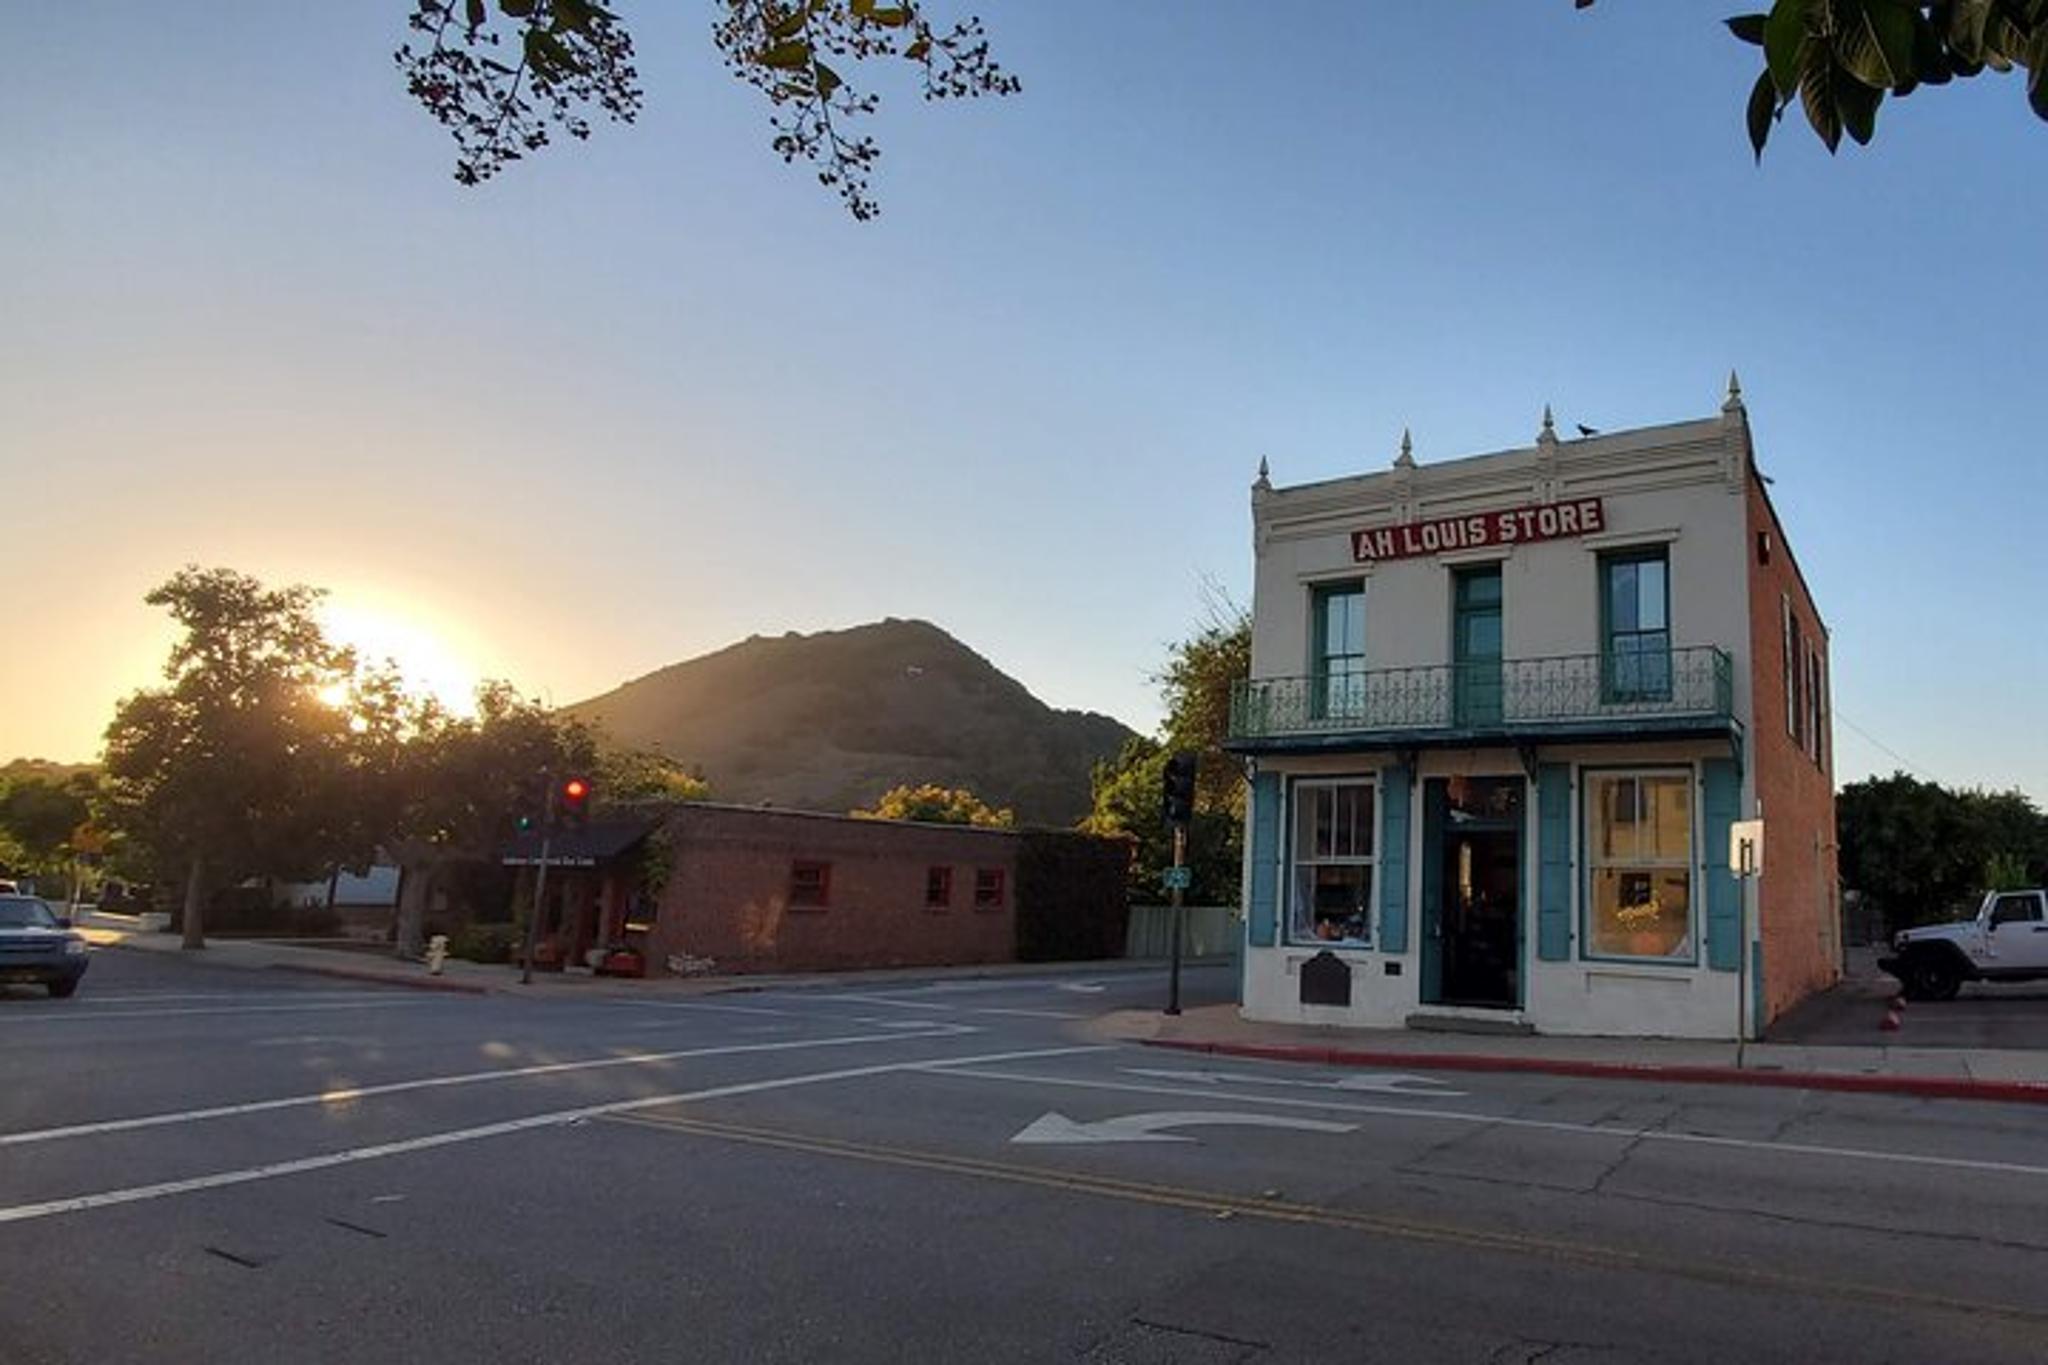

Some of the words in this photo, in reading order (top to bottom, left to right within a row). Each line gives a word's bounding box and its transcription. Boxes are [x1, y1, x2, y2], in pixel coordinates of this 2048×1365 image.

[1358, 531, 1394, 559] AH
[1404, 519, 1487, 553] LOUIS
[1499, 501, 1600, 541] STORE
